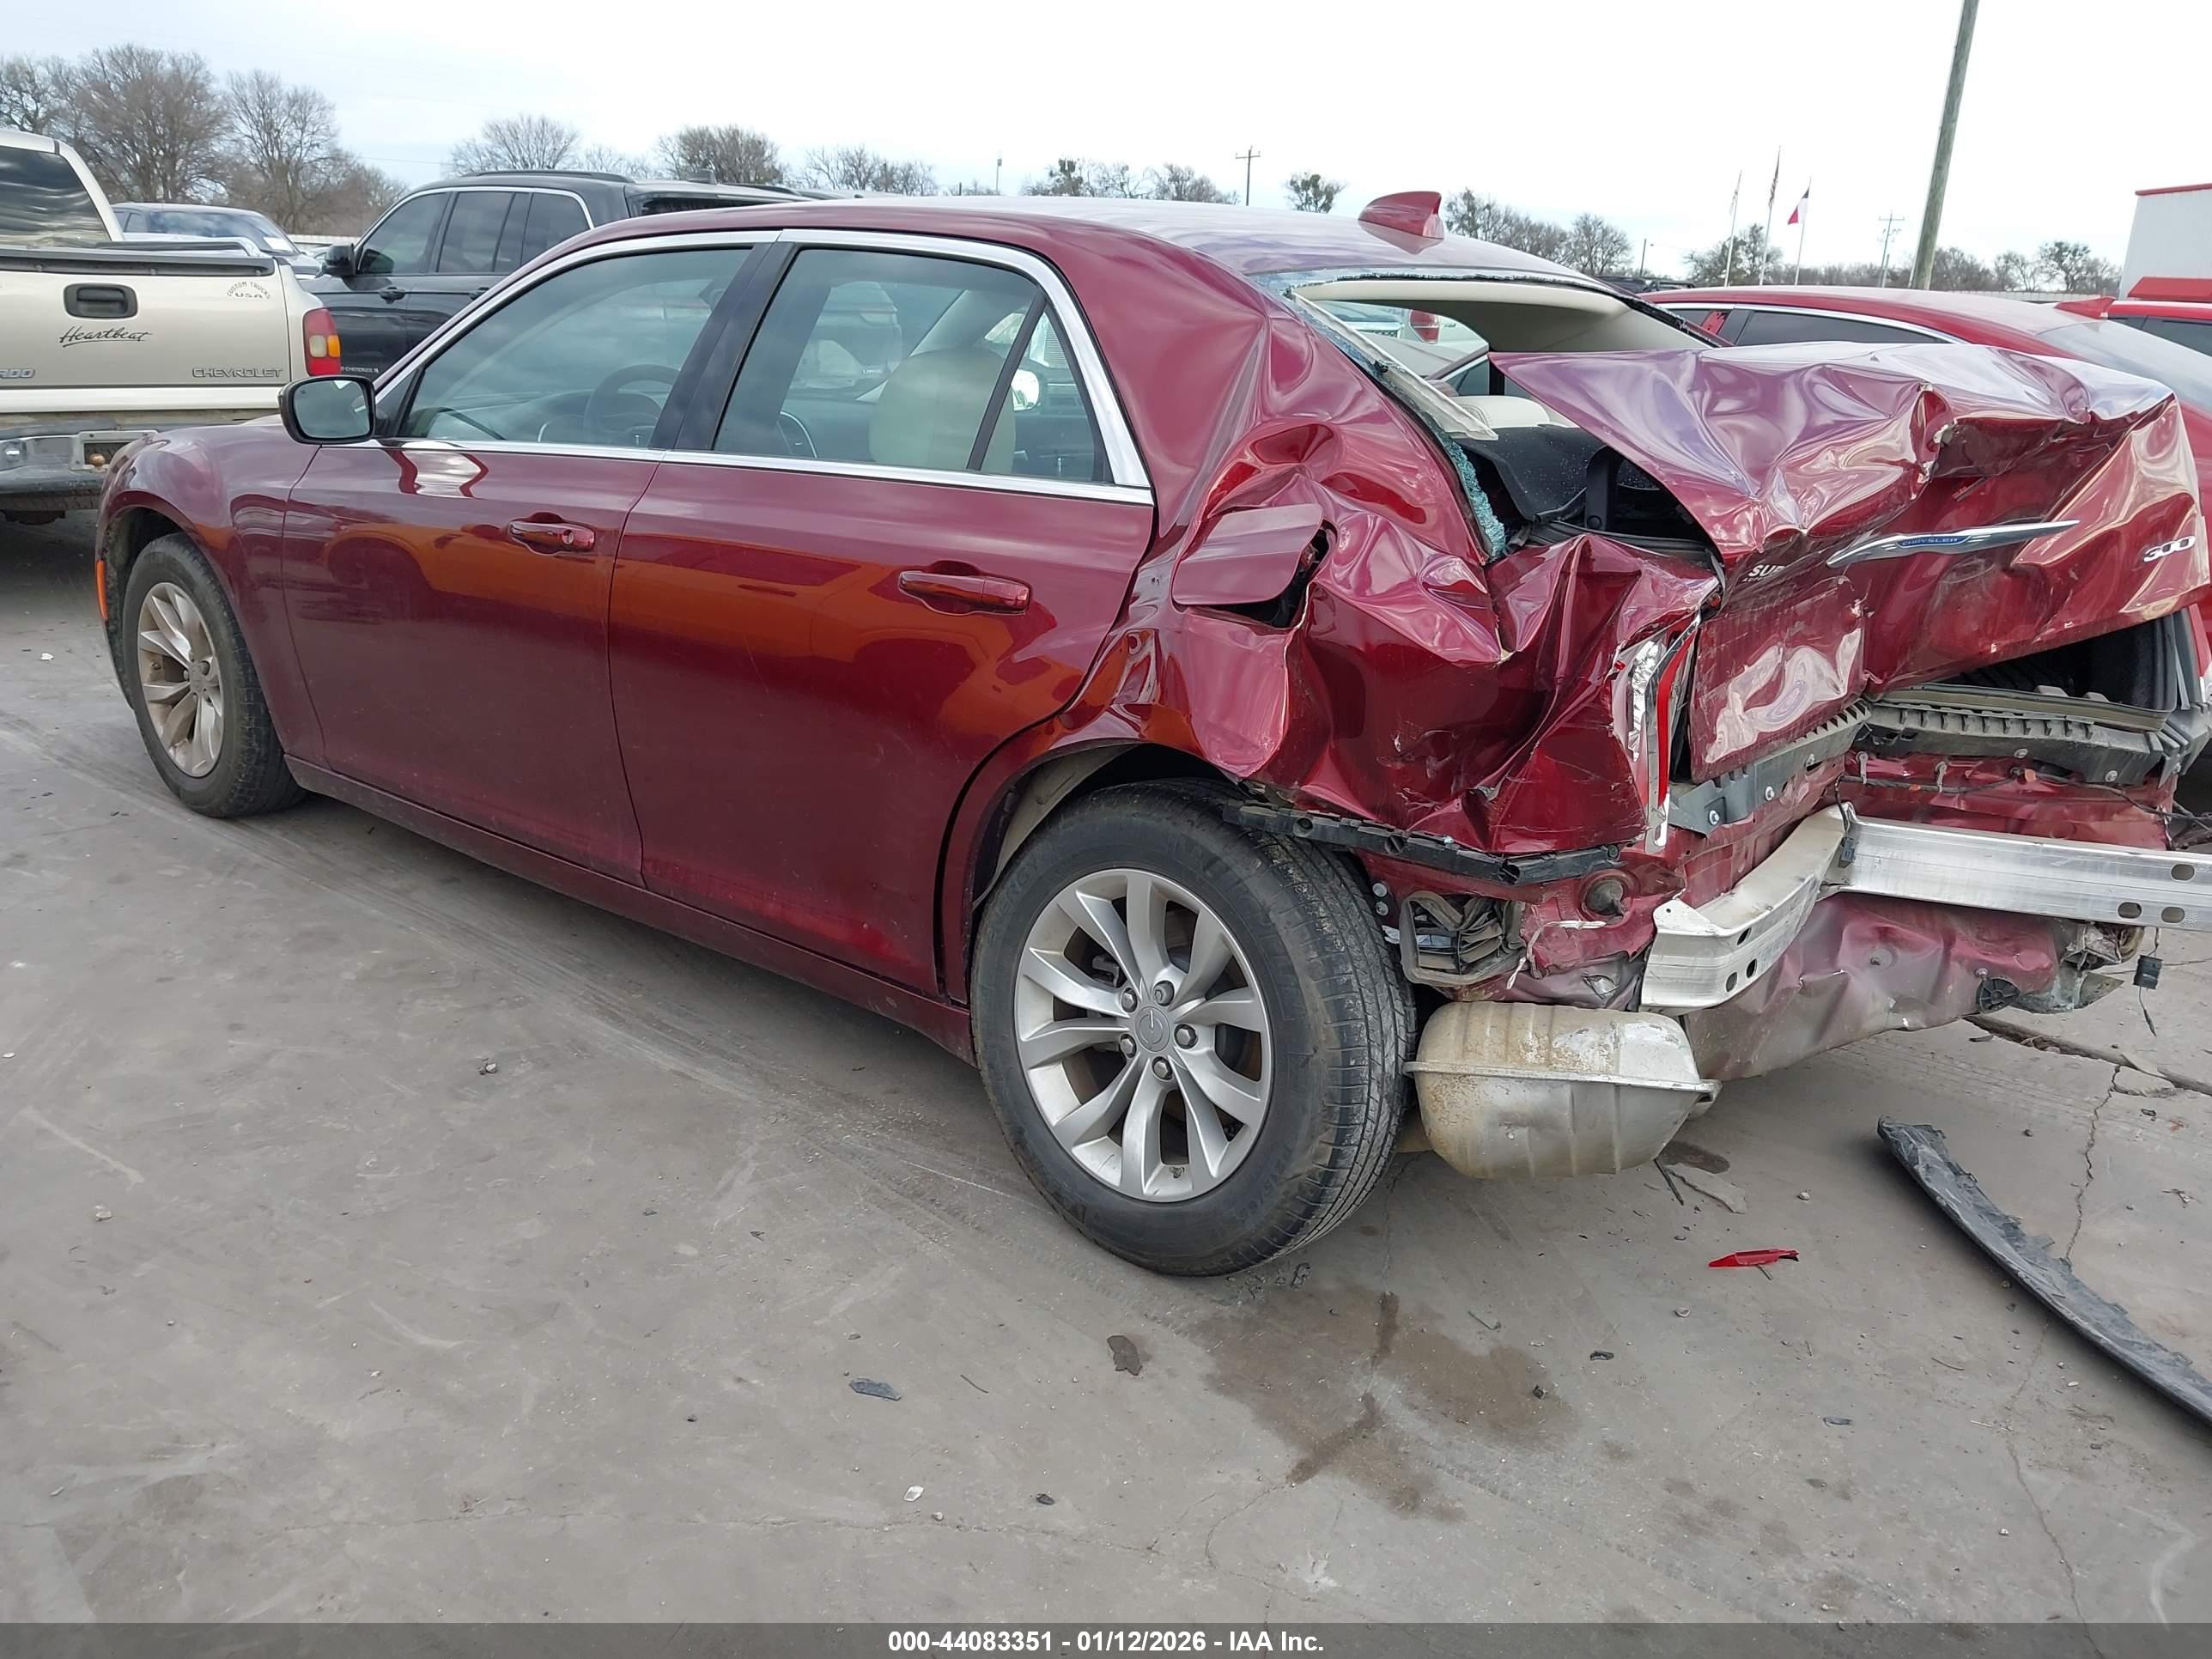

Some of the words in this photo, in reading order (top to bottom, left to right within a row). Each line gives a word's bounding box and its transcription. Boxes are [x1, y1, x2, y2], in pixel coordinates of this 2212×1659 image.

[227, 281, 247, 297] CUSTOM
[250, 282, 271, 300] TRUCKS
[58, 325, 152, 346] Heartbeat
[192, 368, 283, 378] CHEVROLET
[1902, 537, 1959, 547] CHRYSLER
[2143, 535, 2197, 562] 300
